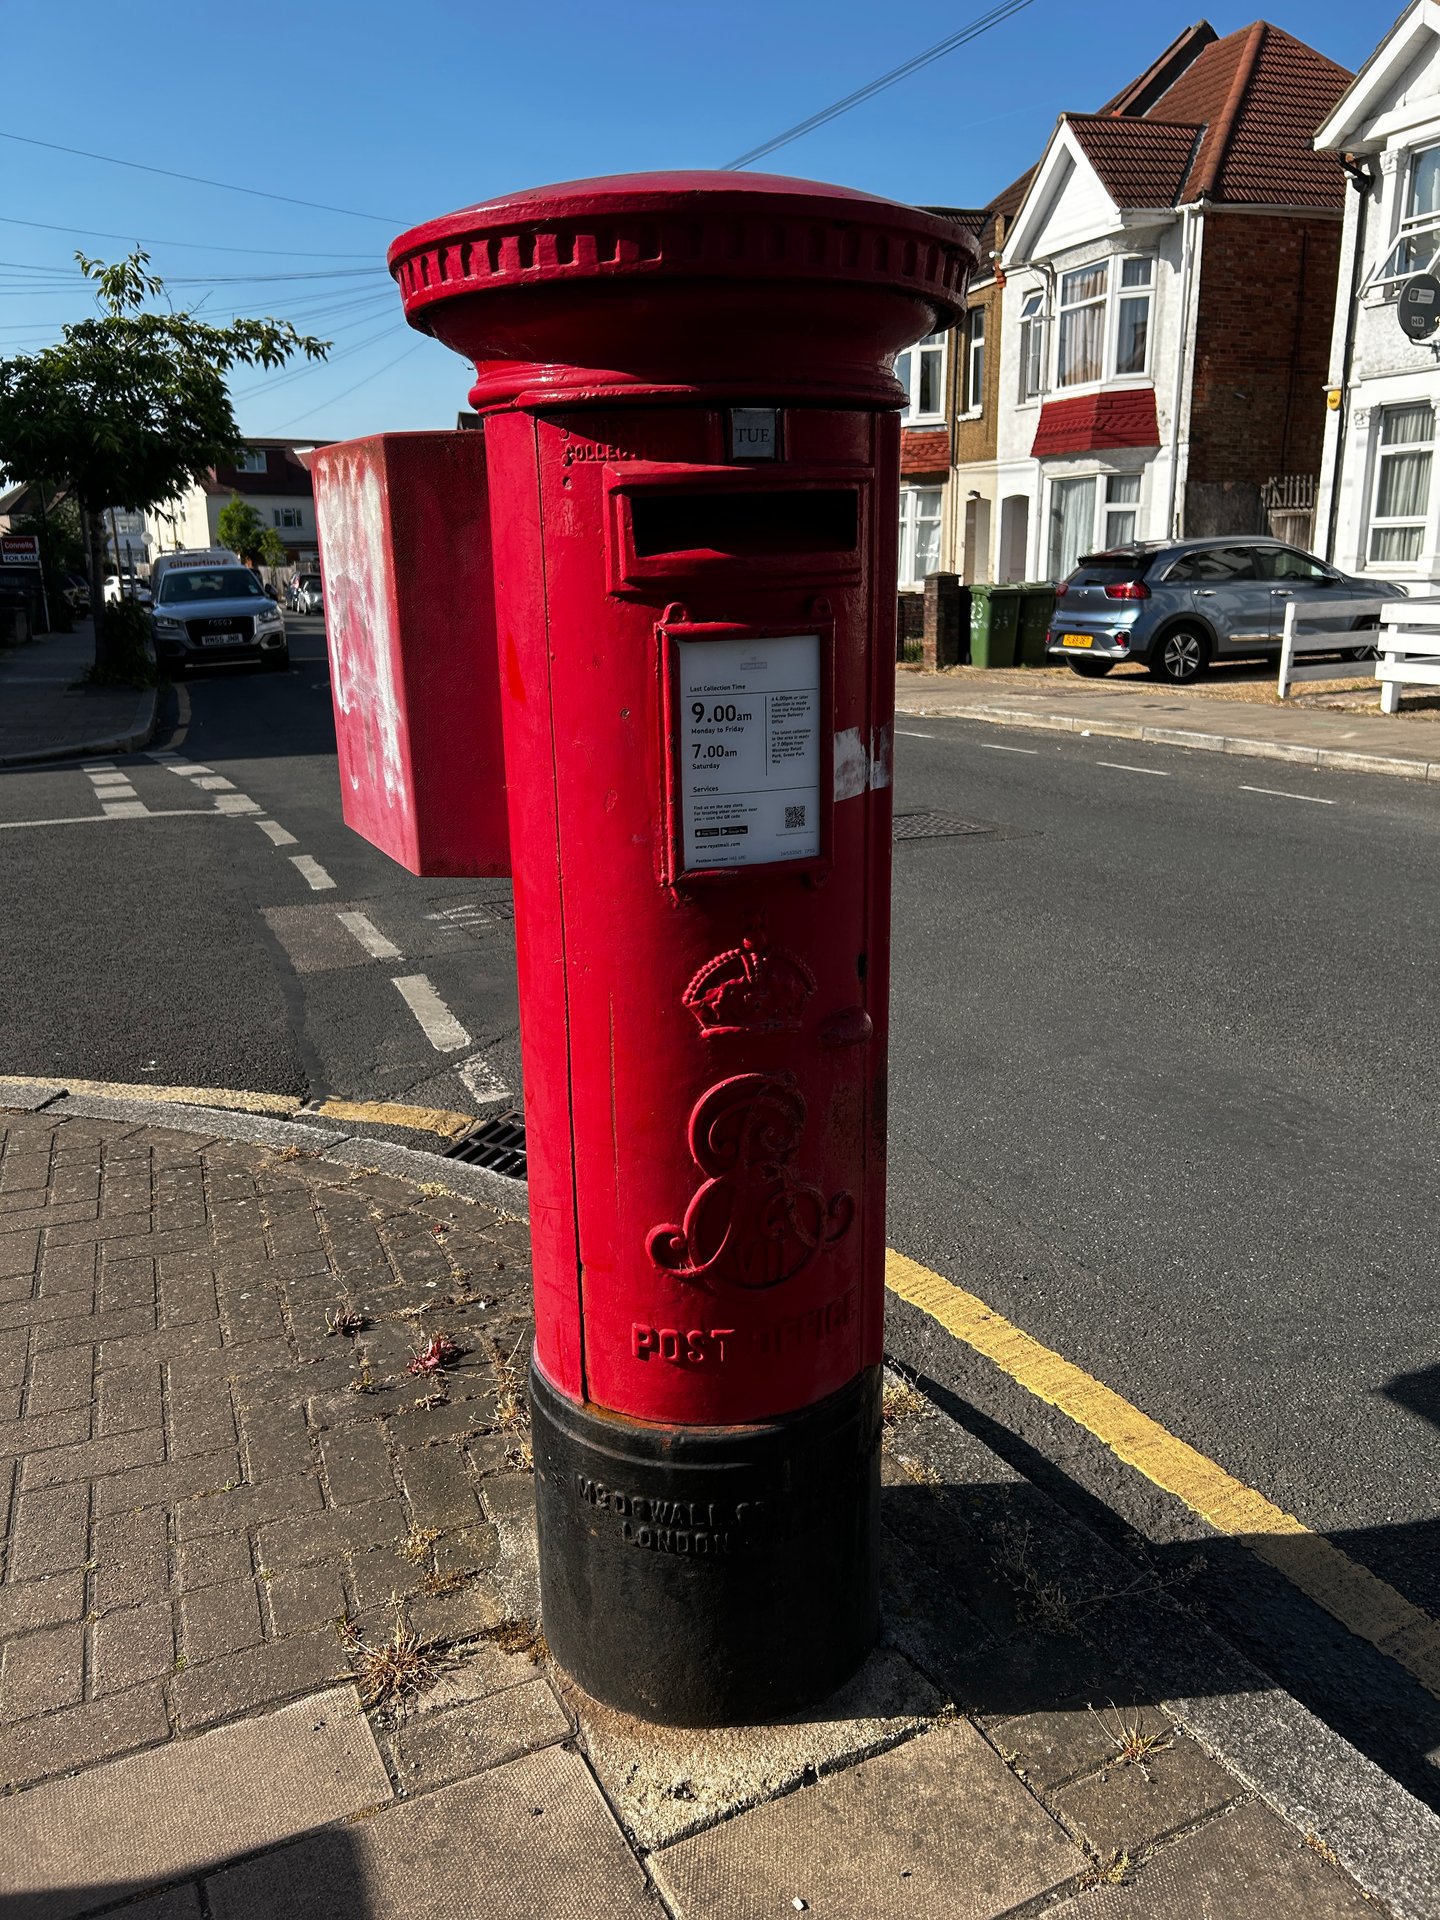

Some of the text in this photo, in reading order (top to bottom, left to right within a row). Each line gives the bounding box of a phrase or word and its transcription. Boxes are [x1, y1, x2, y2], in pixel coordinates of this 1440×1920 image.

[1412, 317, 1424, 325] HD
[735, 428, 770, 443] TUE
[4, 541, 34, 549] Connells
[691, 702, 752, 724] 9.00am
[692, 744, 737, 759] 7.00am
[632, 1322, 737, 1362] POST
[622, 1520, 730, 1555] LONDON
